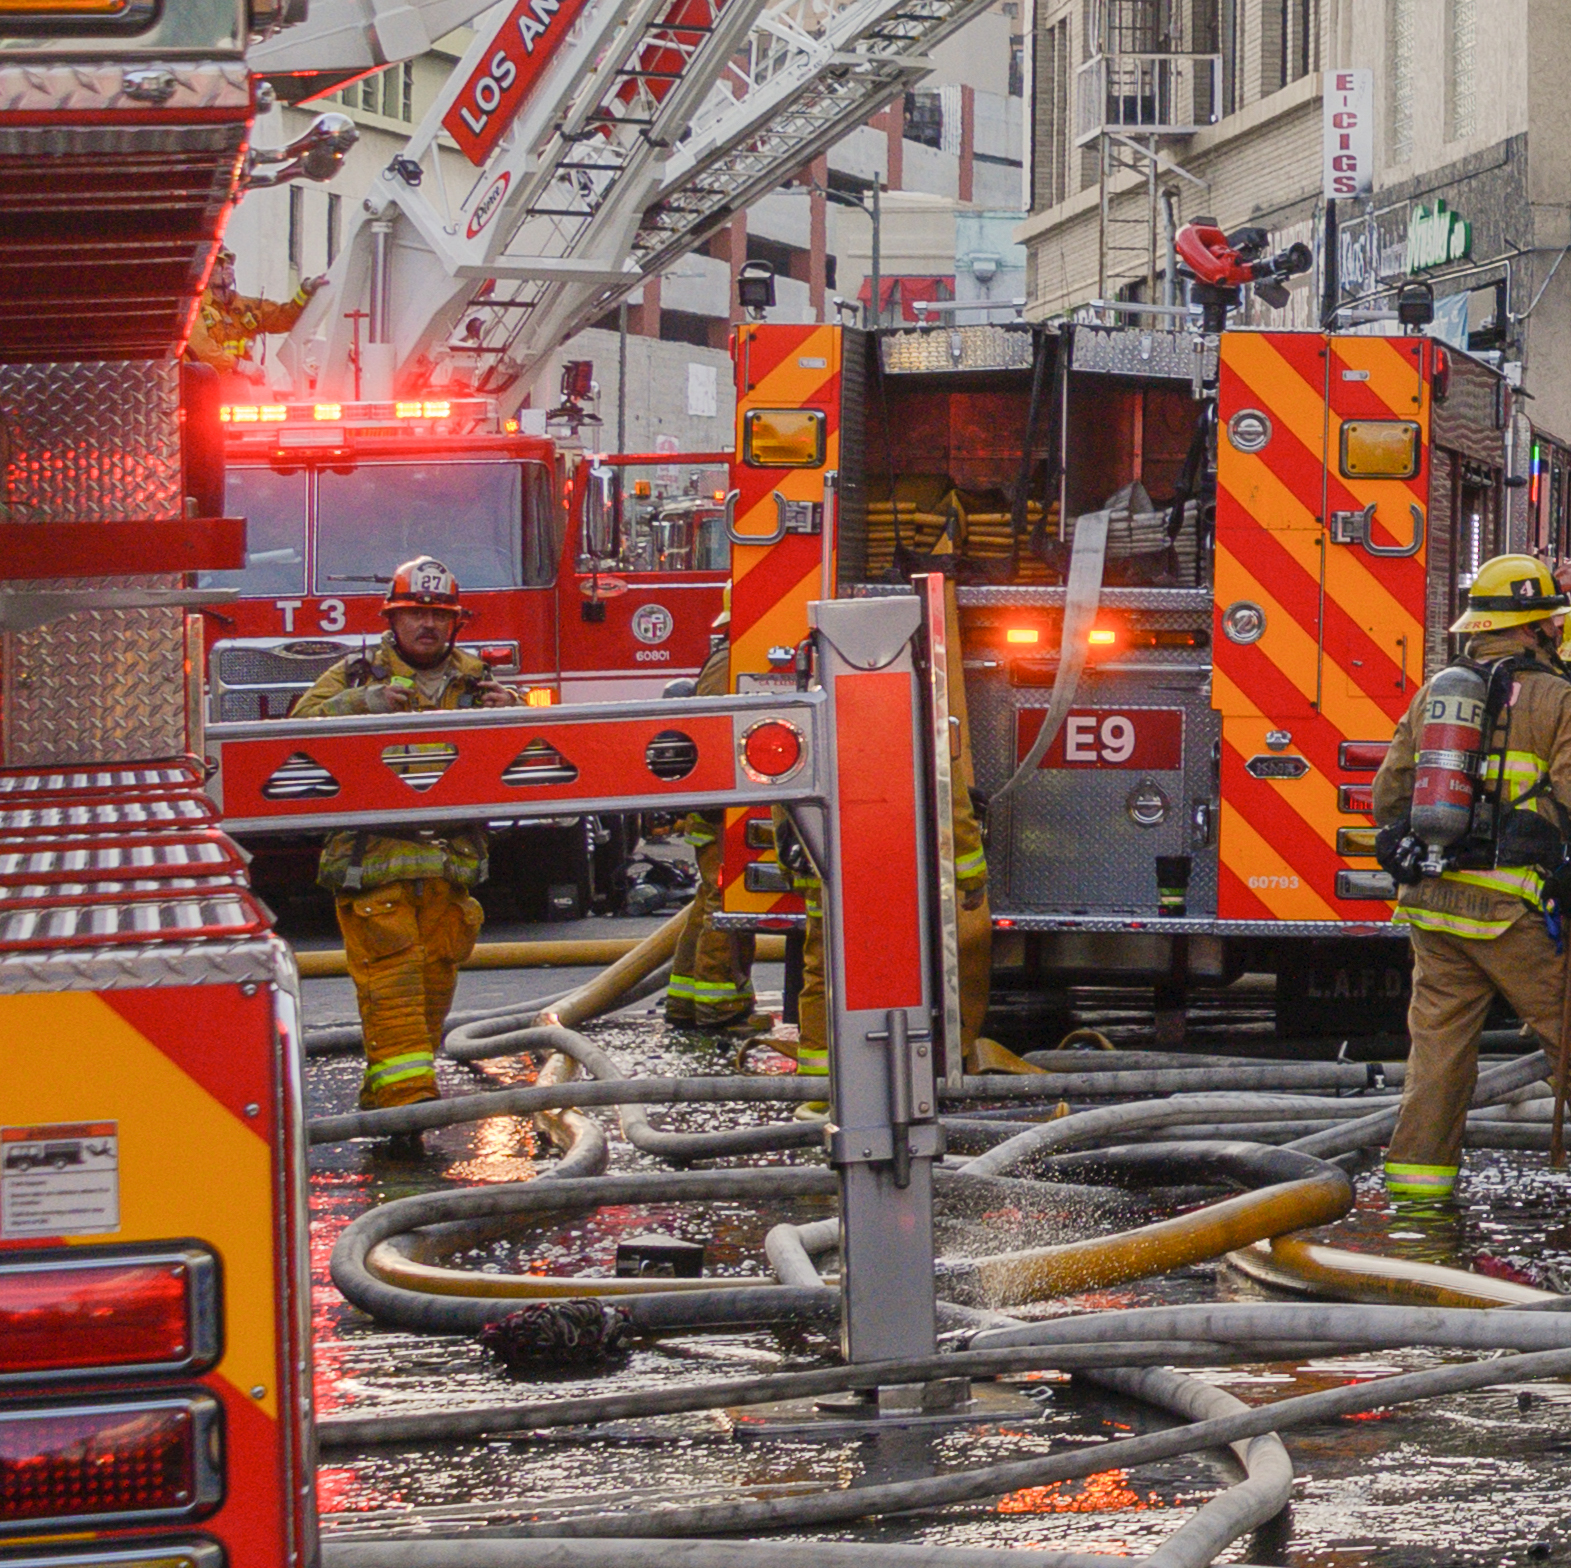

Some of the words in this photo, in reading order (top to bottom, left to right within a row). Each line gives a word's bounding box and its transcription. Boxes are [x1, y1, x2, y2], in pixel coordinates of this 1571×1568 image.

[460, 50, 517, 138] LOS
[1333, 73, 1358, 194] E-CIGS
[475, 184, 502, 227] Pierce
[421, 574, 442, 591] 27
[1521, 579, 1535, 598] 4
[635, 649, 671, 663] 60801
[1066, 716, 1137, 763] E9
[1247, 876, 1300, 890] 60793
